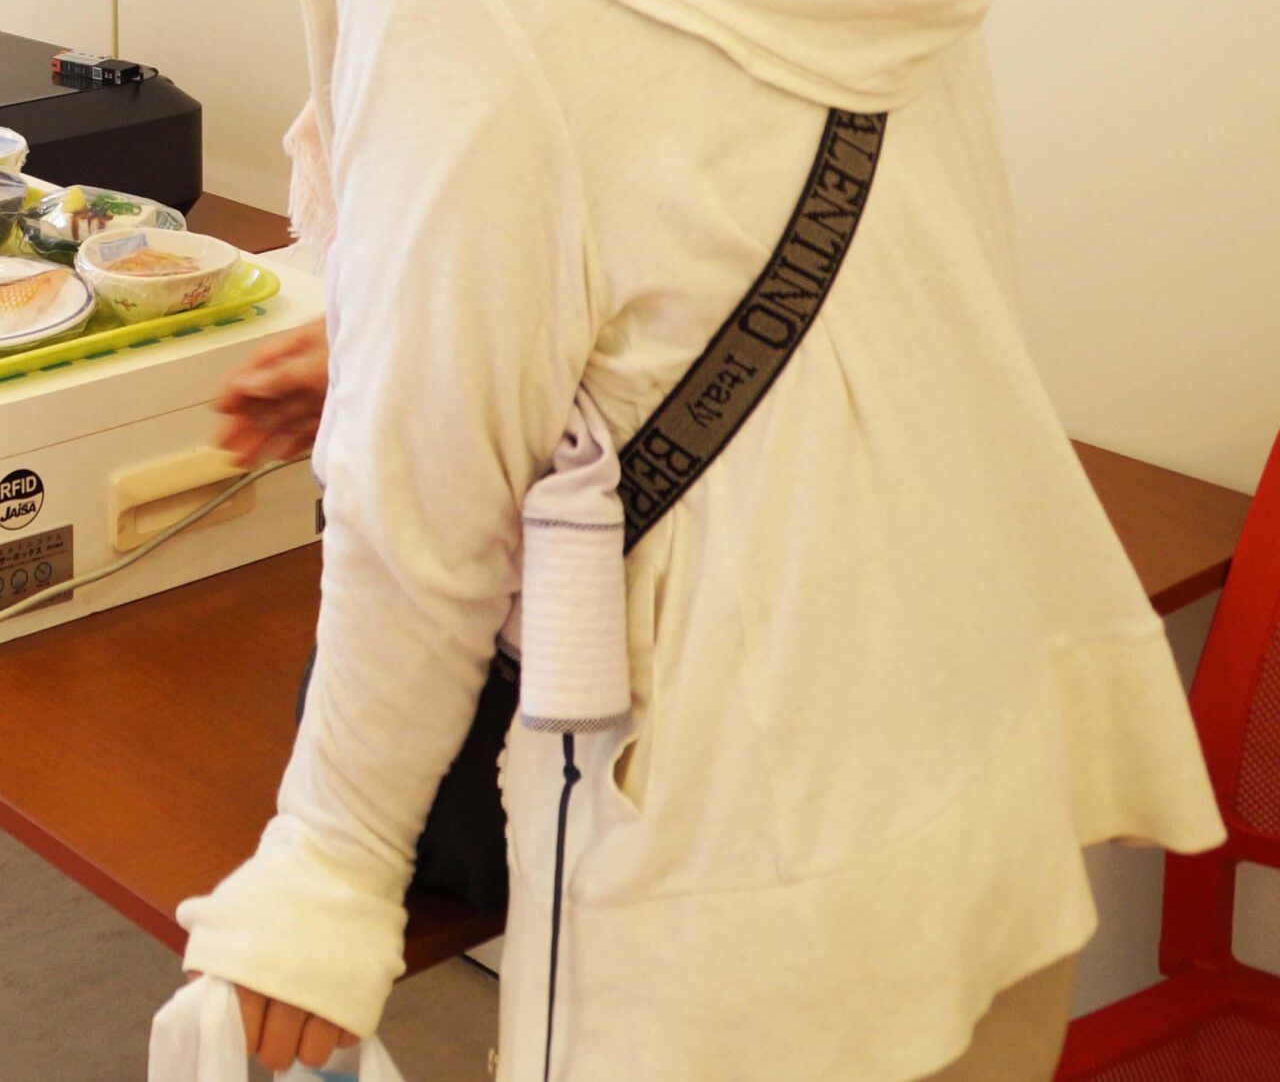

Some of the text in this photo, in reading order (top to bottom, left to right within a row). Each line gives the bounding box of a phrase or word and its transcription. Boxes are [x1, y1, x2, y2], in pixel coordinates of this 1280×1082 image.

[623, 112, 880, 531] ALENTINO Italy BER
[0, 475, 37, 500] RFID
